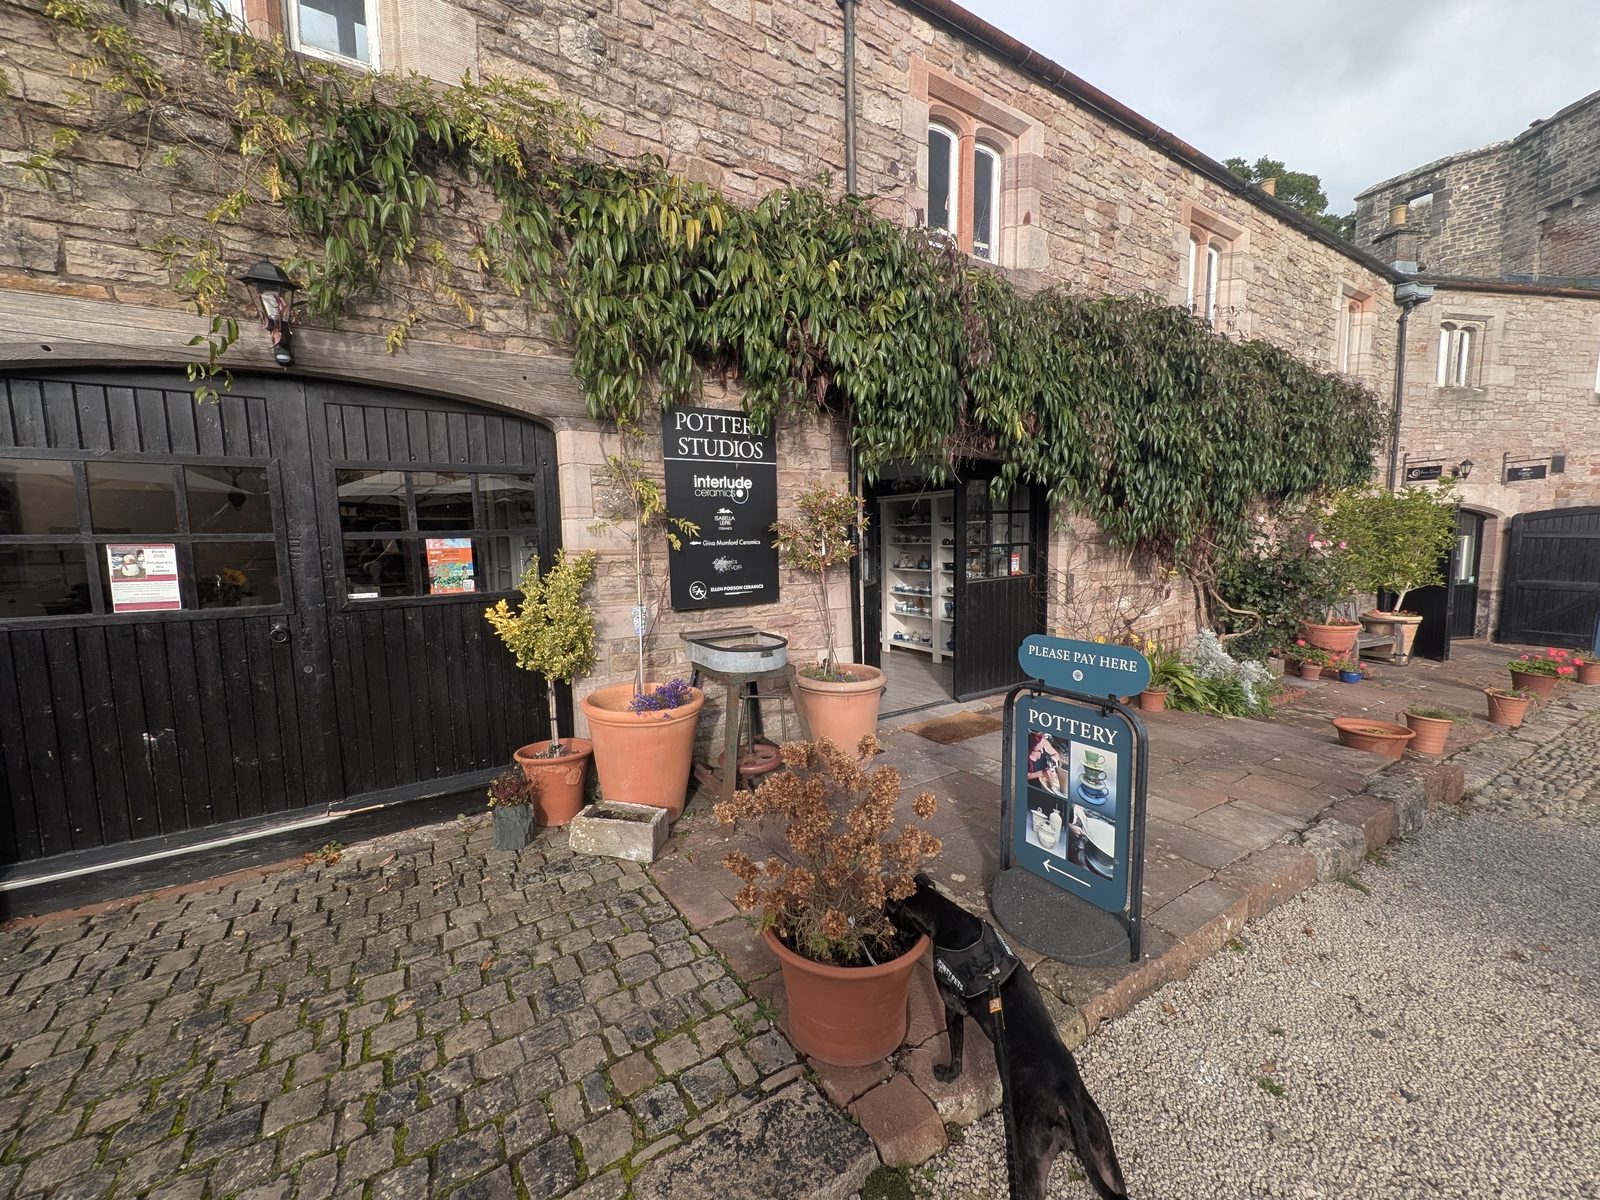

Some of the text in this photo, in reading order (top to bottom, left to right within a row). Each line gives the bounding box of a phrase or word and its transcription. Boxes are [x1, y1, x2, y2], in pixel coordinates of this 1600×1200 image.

[675, 412, 764, 436] POTTER
[678, 437, 763, 459] STUDIOS
[693, 475, 753, 489] interlude
[694, 489, 736, 497] ceramics
[1028, 645, 1138, 672] PLEASE PAY HERE
[1028, 708, 1118, 746] POTTERY
